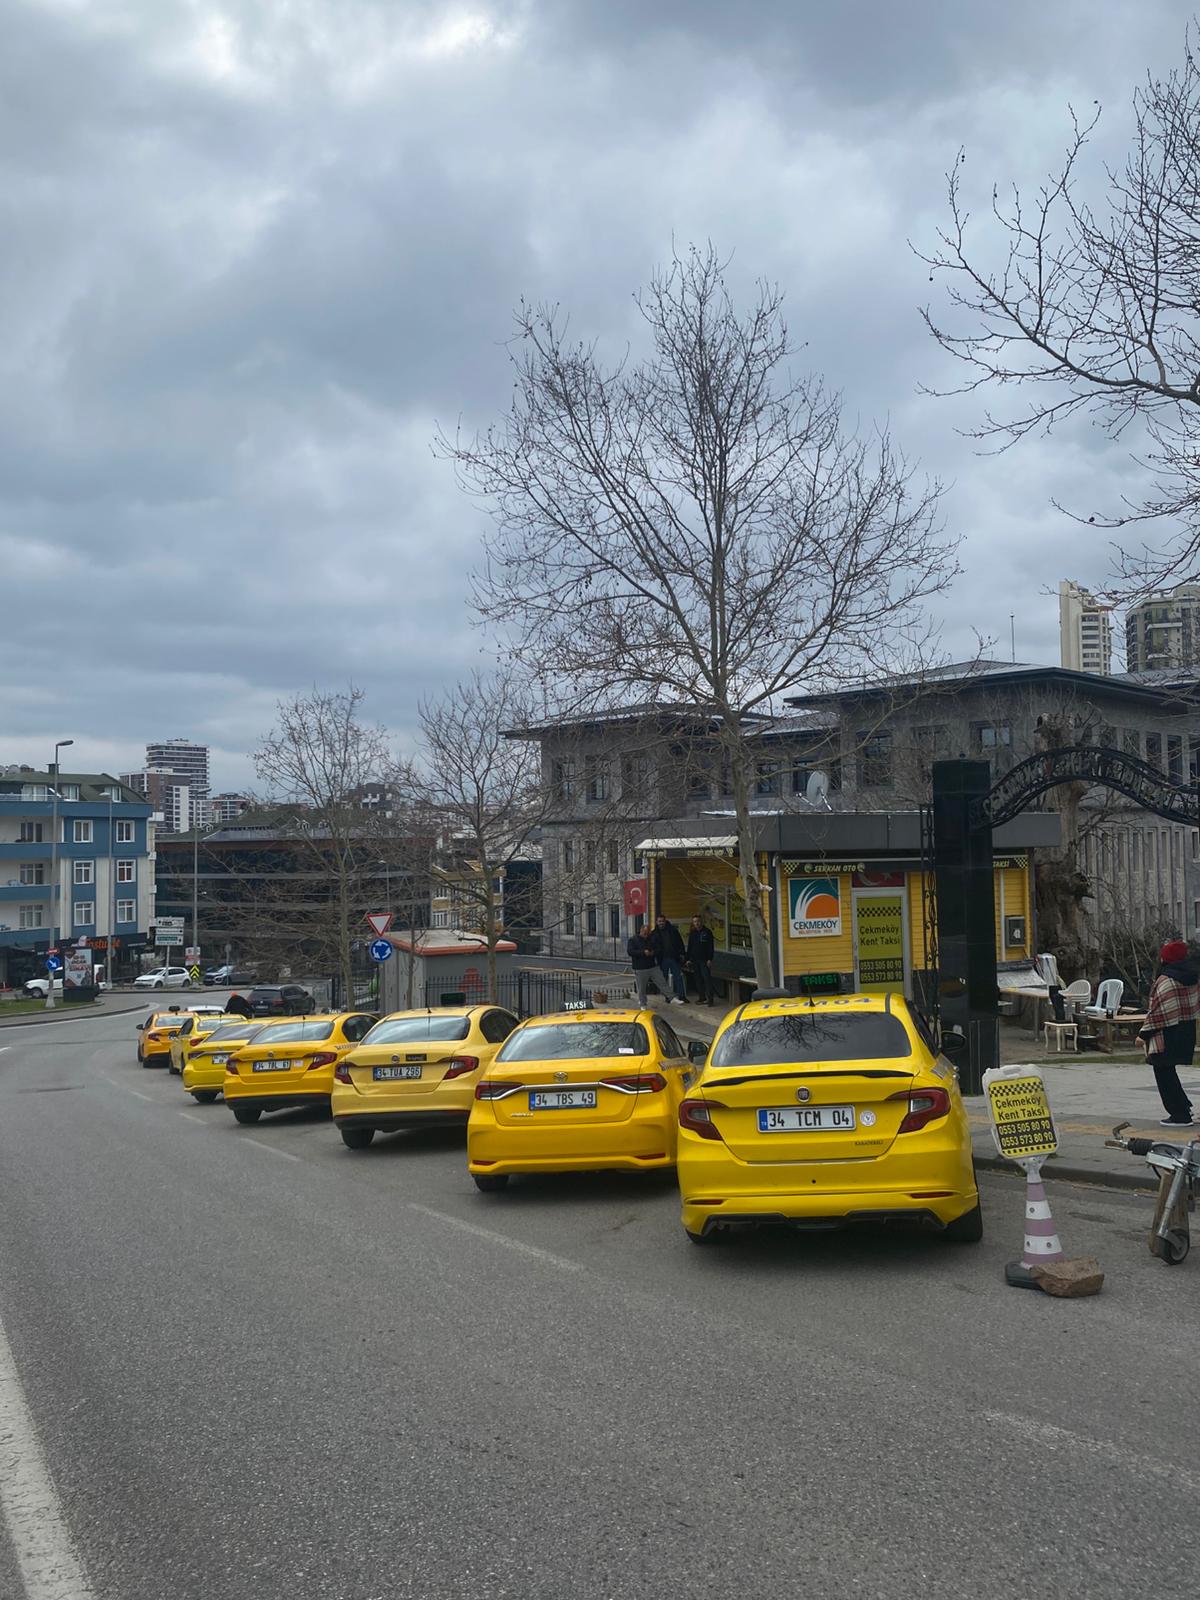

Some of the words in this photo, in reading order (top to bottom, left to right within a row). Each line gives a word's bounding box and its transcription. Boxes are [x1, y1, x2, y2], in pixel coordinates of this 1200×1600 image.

[794, 919, 838, 930] ÇEKMEKÖY
[860, 937, 879, 946] Kent
[880, 936, 900, 945] Taksi
[377, 1068, 386, 1077] 34
[536, 1094, 547, 1105] 34
[556, 1094, 574, 1105] TBS
[581, 1093, 594, 1104] 49
[769, 1112, 784, 1127] 34
[796, 1111, 821, 1126] TCM
[832, 1110, 850, 1125] 04
[998, 1111, 1020, 1121] Kent
[1020, 1106, 1045, 1118] Taksi
[998, 1124, 1016, 1135] 0553
[1017, 1122, 1031, 1132] 505
[1031, 1121, 1040, 1131] 80
[1041, 1120, 1050, 1129] 90
[1001, 1136, 1019, 1147] 0553
[1019, 1134, 1033, 1144] 573
[1033, 1133, 1043, 1143] 80
[1043, 1132, 1053, 1141] 90
